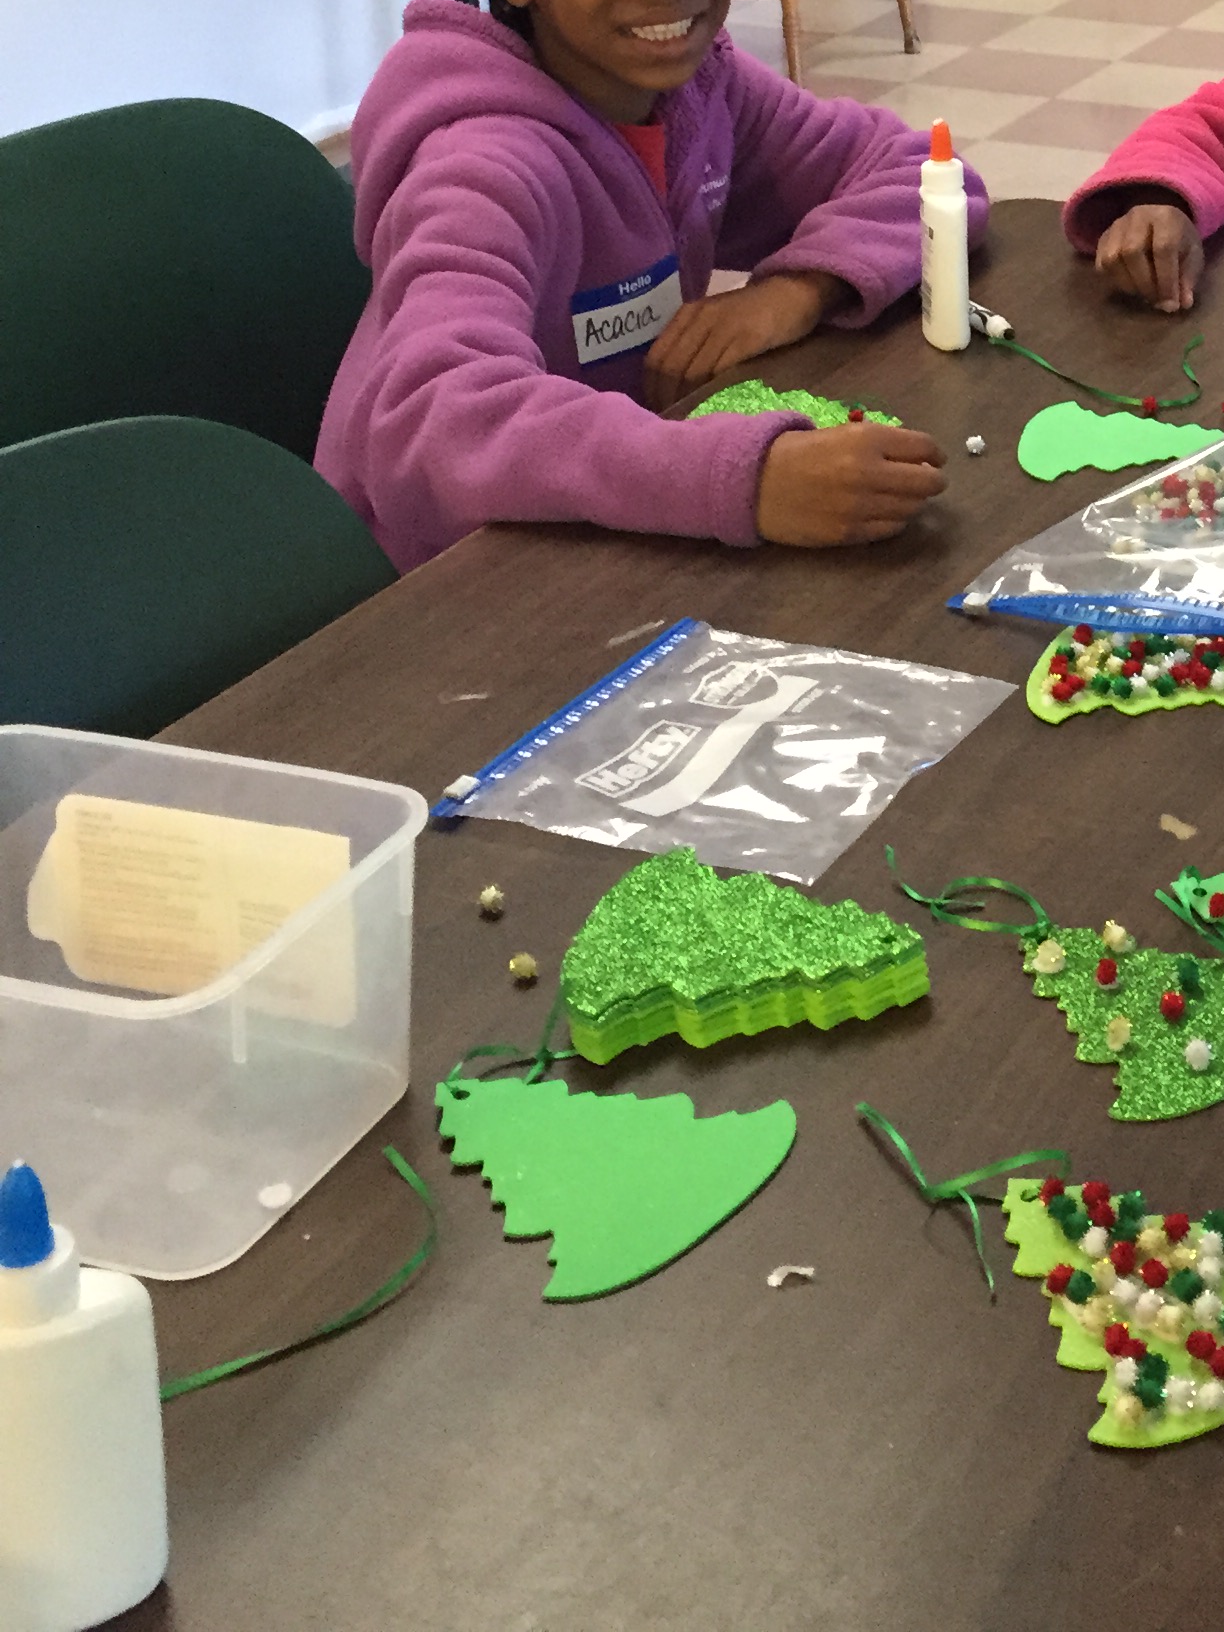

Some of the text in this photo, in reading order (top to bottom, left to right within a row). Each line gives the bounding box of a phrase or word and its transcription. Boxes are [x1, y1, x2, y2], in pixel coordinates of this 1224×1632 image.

[618, 274, 652, 296] Hello
[585, 304, 661, 347] Acacia
[586, 724, 692, 793] Hefty
